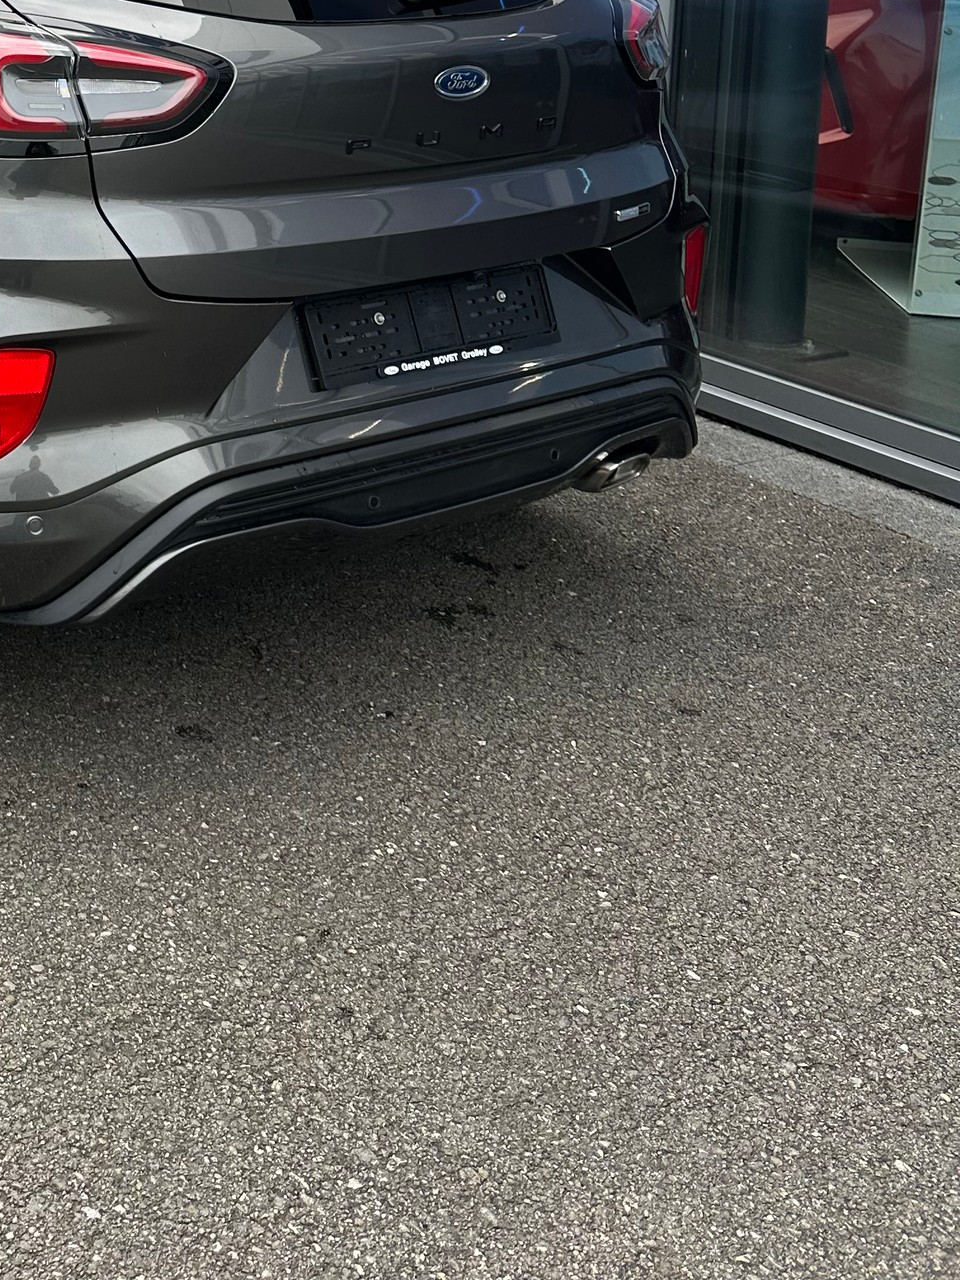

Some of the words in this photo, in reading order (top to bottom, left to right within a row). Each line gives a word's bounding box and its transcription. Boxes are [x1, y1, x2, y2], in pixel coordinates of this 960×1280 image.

[447, 71, 478, 91] Ford
[345, 116, 558, 155] PUMA
[401, 359, 431, 372] Garage
[432, 352, 459, 366] BOVET
[461, 347, 488, 360] Grolley
